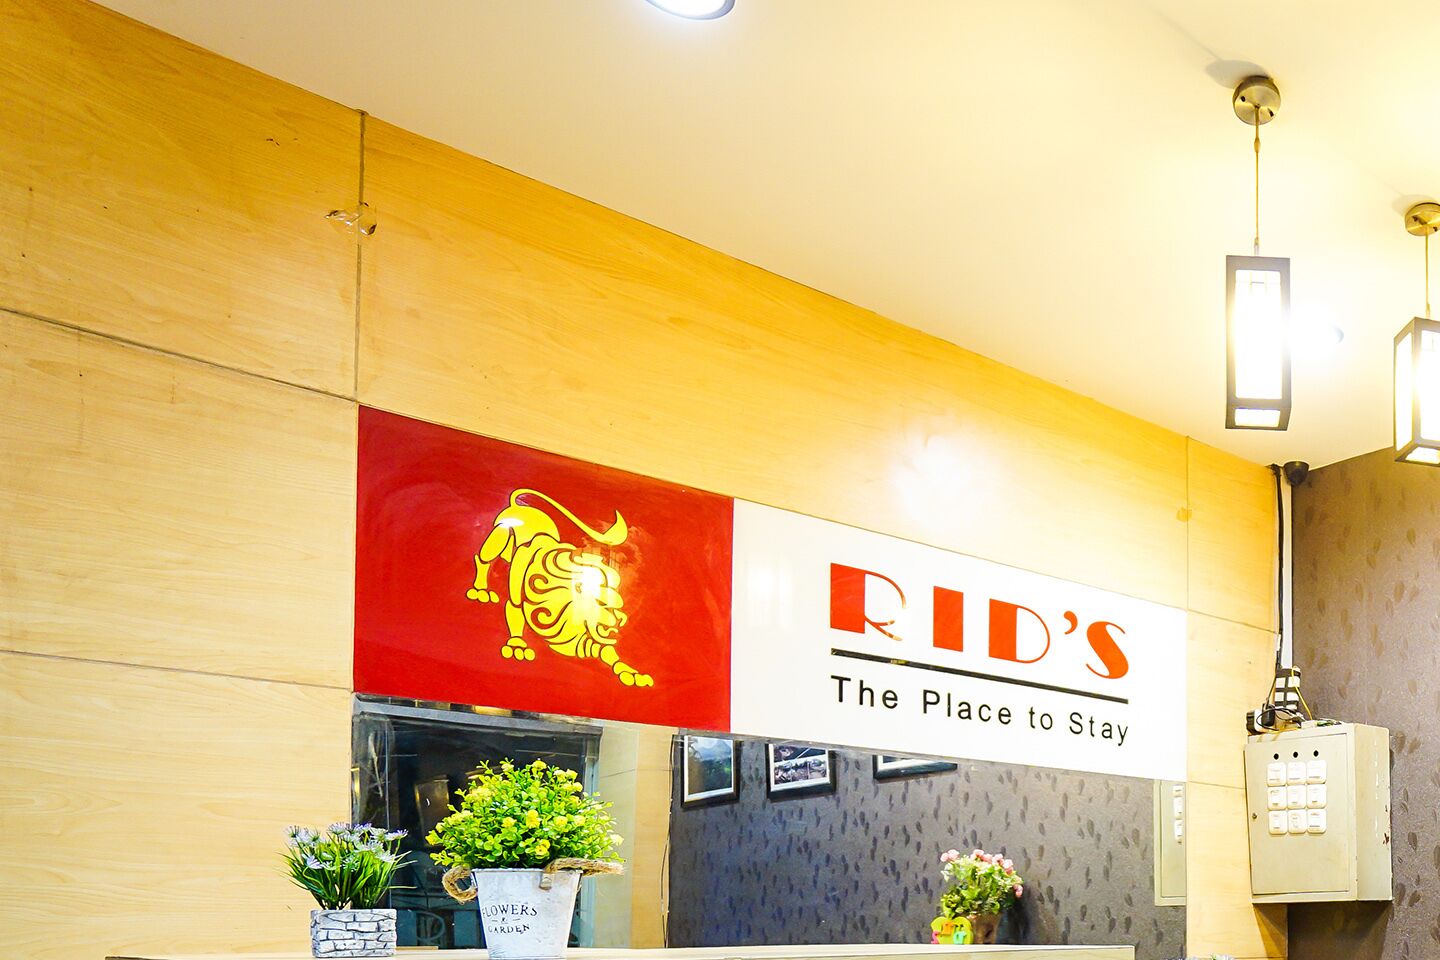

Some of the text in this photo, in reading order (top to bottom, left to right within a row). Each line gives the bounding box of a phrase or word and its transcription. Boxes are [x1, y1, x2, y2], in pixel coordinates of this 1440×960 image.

[830, 562, 1129, 679] RID'S
[830, 674, 1129, 747] The Place to Stay
